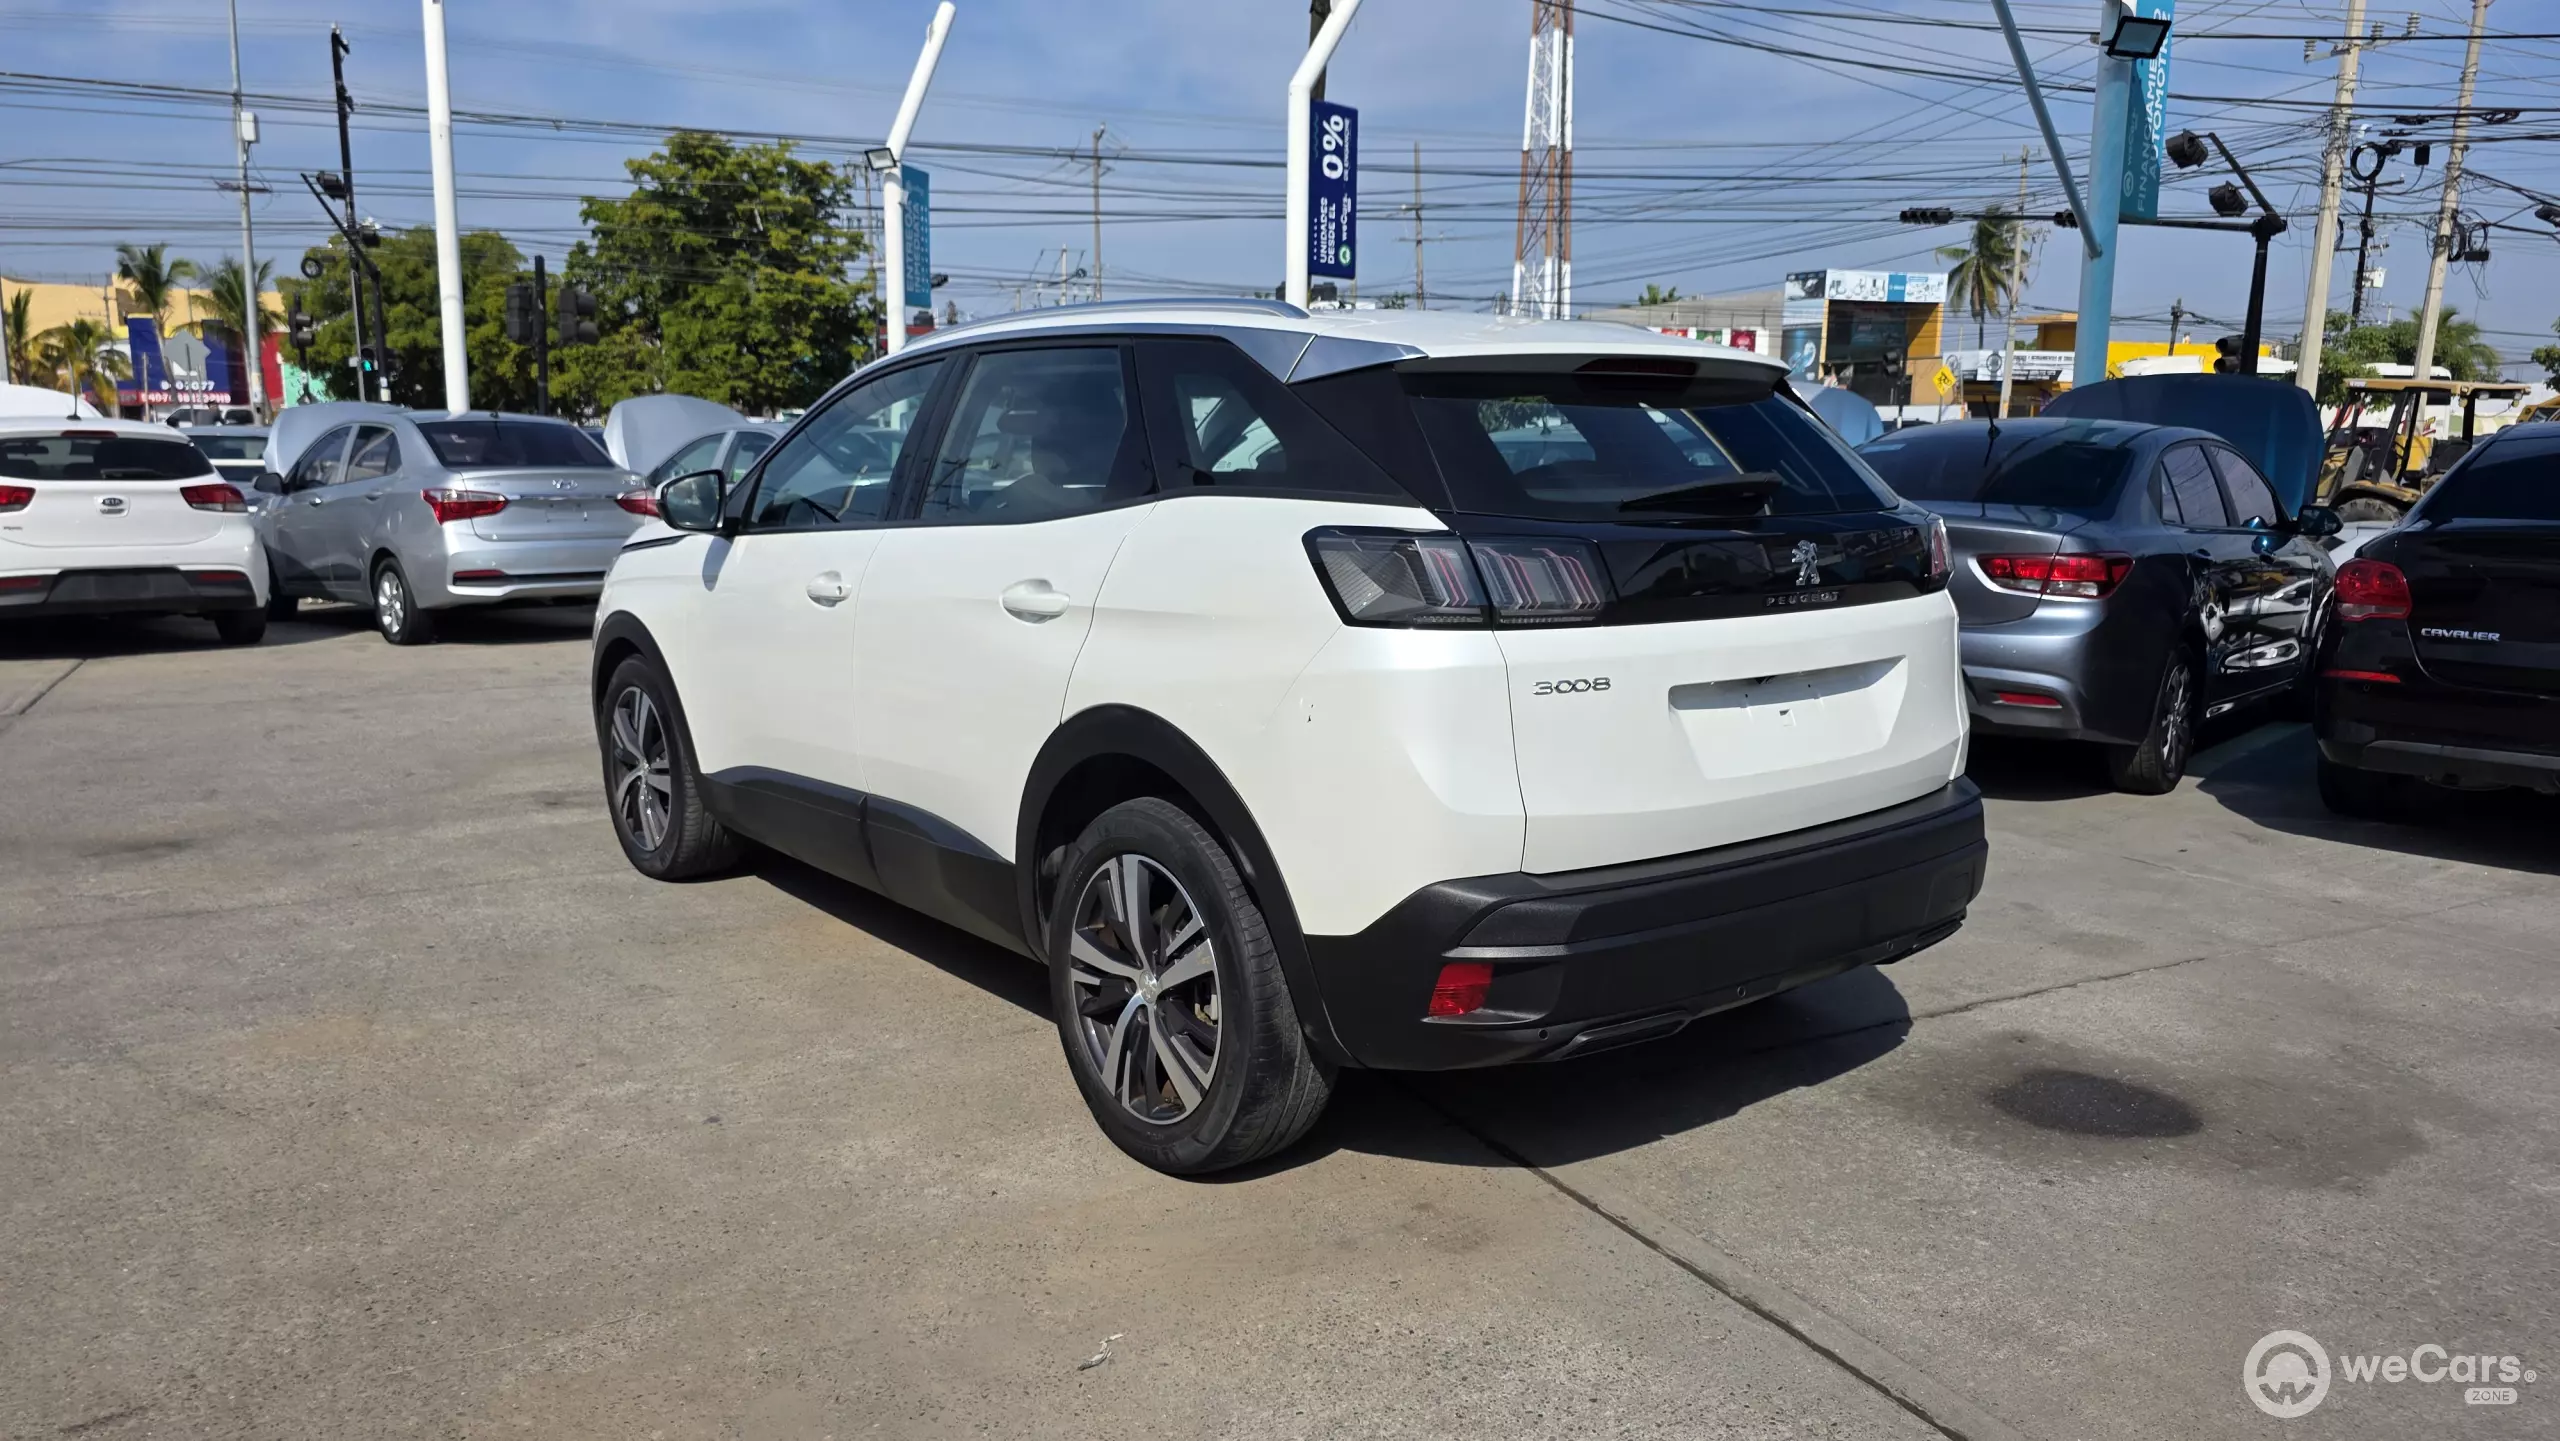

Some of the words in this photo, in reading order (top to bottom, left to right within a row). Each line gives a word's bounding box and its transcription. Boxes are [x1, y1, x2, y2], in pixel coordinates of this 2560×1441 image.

[1322, 115, 1344, 180] 0%
[1328, 203, 1336, 219] EL
[1320, 197, 1328, 264] UNIDADES
[1327, 224, 1336, 264] DESDE
[1766, 591, 1839, 606] PEUGEOT
[2421, 628, 2500, 641] CAVALIER
[1532, 677, 1611, 695] 3008
